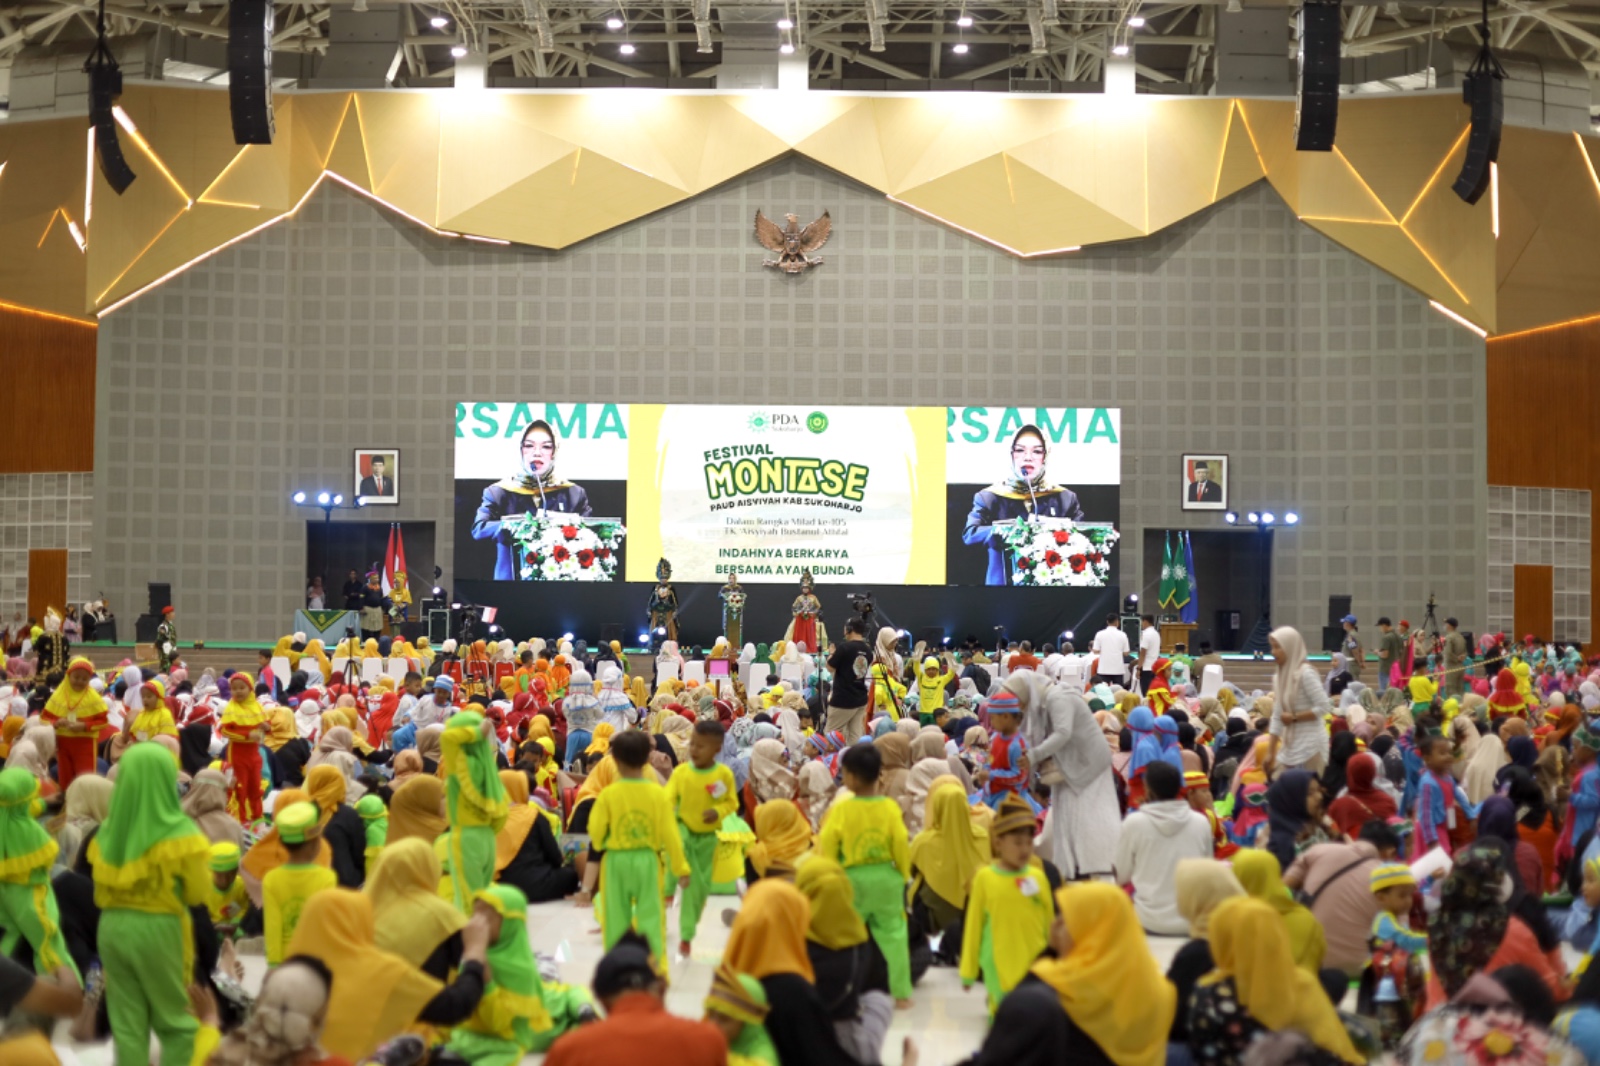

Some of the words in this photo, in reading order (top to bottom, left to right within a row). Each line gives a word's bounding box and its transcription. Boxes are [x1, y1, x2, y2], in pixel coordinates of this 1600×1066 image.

[772, 413, 799, 425] PDA
[704, 444, 773, 462] FESTIVAL
[704, 457, 869, 501] MONTASE
[710, 501, 735, 512] PAUD
[737, 497, 781, 507] AISYIYAH
[783, 497, 803, 505] KAB
[804, 498, 863, 513] SUKOHARJO
[726, 517, 755, 525] Dalam
[757, 517, 789, 527] Rangka
[791, 517, 815, 525] Milad
[719, 549, 783, 558] INDAHNYA
[785, 549, 849, 558] BERKARYA
[715, 565, 772, 575] BERSAMA
[812, 566, 855, 575] BUNDA
